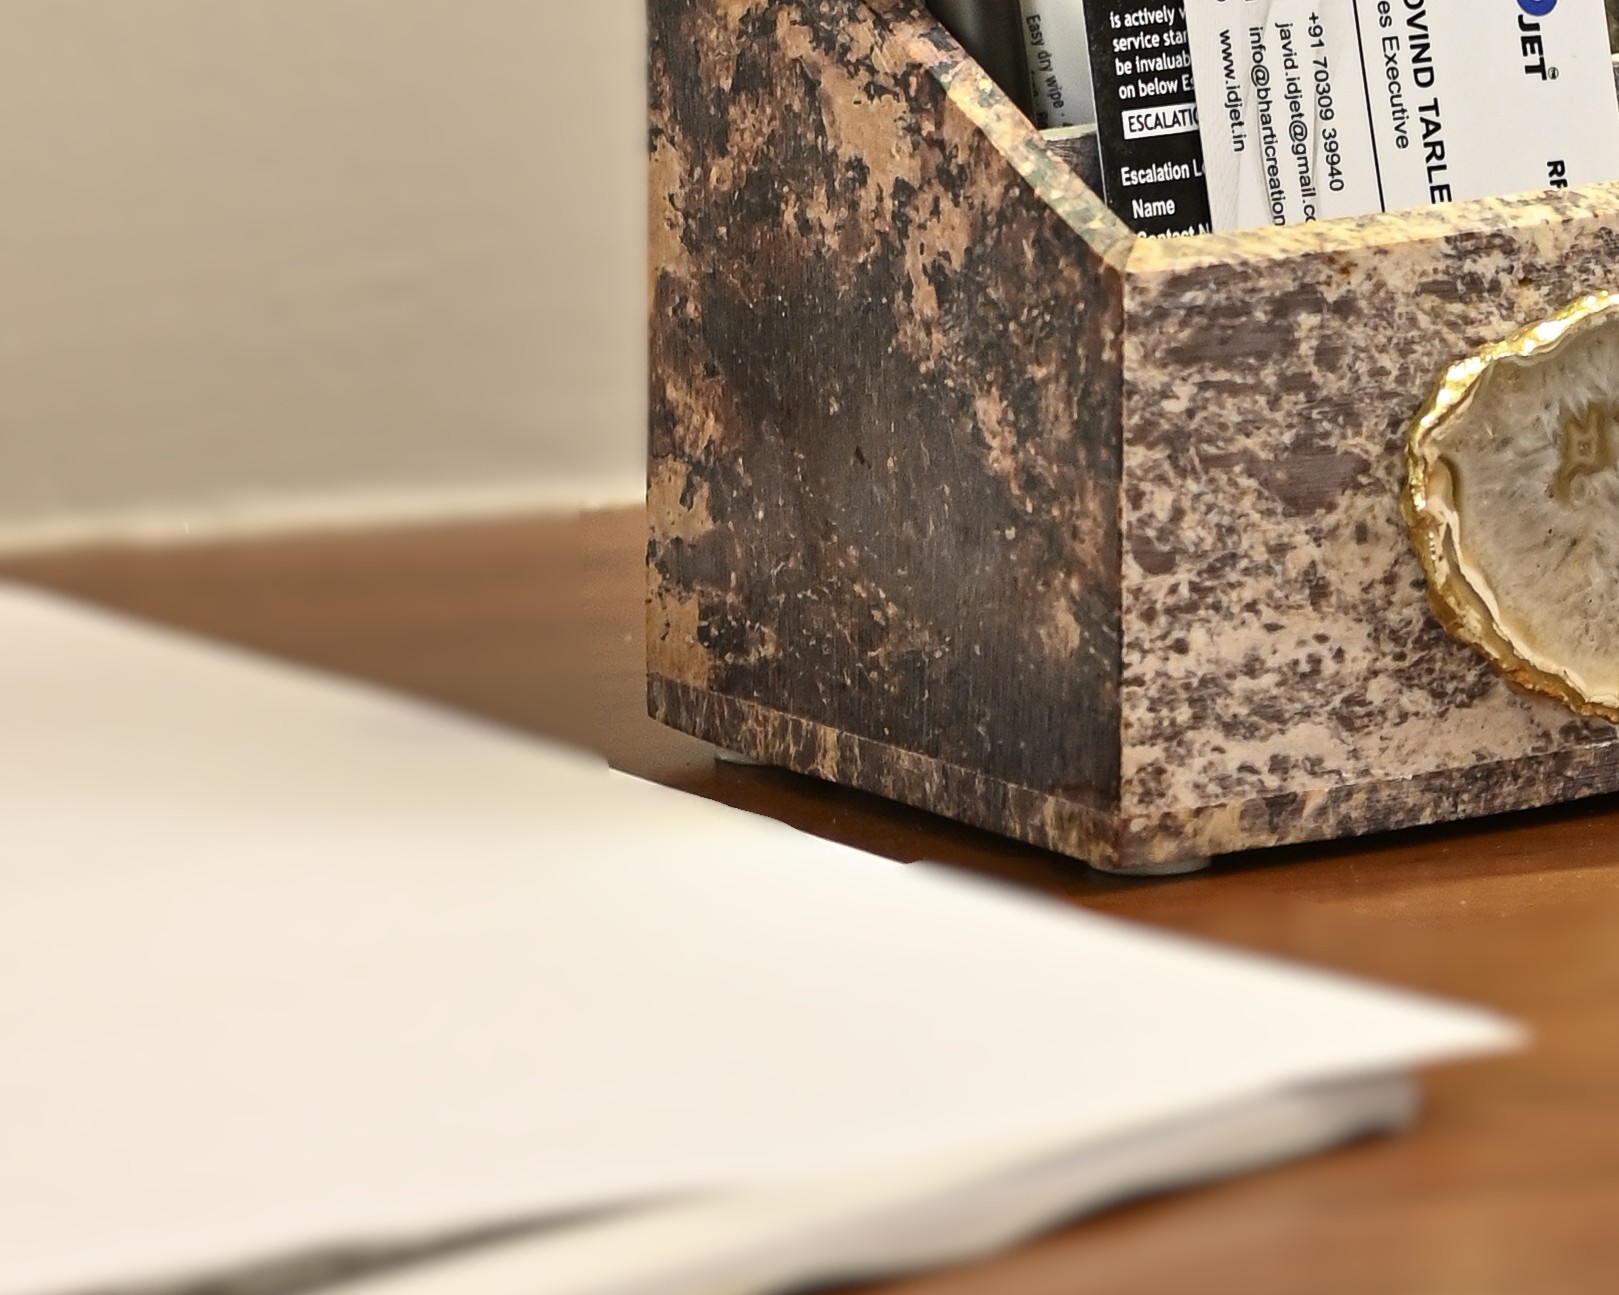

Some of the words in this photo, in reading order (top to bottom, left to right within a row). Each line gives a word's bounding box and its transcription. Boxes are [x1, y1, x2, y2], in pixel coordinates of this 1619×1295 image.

[1109, 11, 1121, 29] is
[1124, 4, 1175, 27] actively
[1112, 31, 1160, 53] service
[1308, 11, 1325, 48] +91
[1026, 14, 1045, 46] Easy
[1037, 49, 1053, 72] dry
[1045, 75, 1065, 109] wipe
[1115, 57, 1132, 76] be
[1135, 49, 1191, 74] invaluab
[1118, 83, 1136, 100] on
[1138, 77, 1178, 97] below
[1219, 29, 1247, 152] www.idjet.in
[1312, 56, 1335, 121] 70309
[1381, 35, 1410, 150] Executive
[1249, 26, 1287, 227] info@bharticreation
[1418, 97, 1453, 204] TARLE
[1120, 161, 1190, 187] Escalation
[1322, 127, 1345, 192] 39940
[1131, 198, 1176, 219] Name
